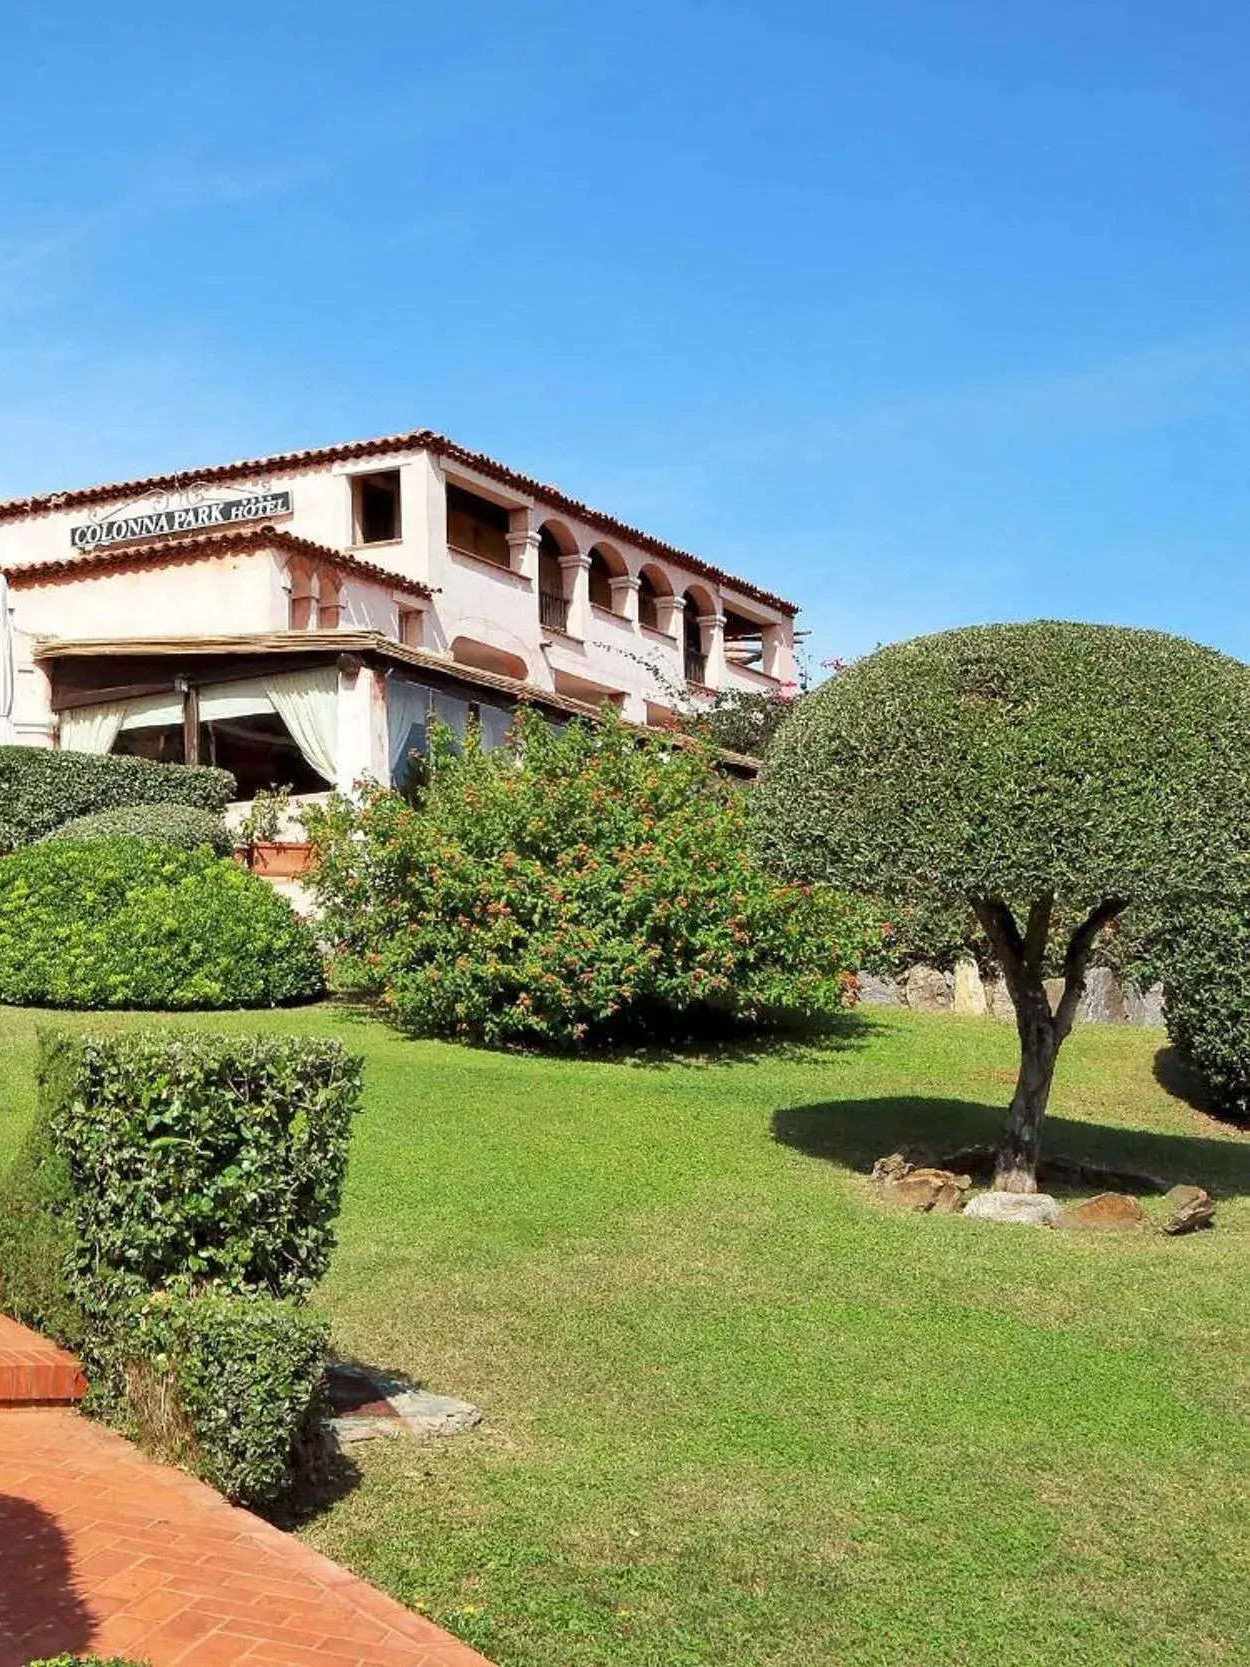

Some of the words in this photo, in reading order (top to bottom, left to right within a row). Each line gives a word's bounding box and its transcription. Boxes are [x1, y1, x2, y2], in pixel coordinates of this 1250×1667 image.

[74, 516, 169, 545] COLONNA
[173, 504, 225, 529] PARK
[230, 499, 287, 518] HOTEL
